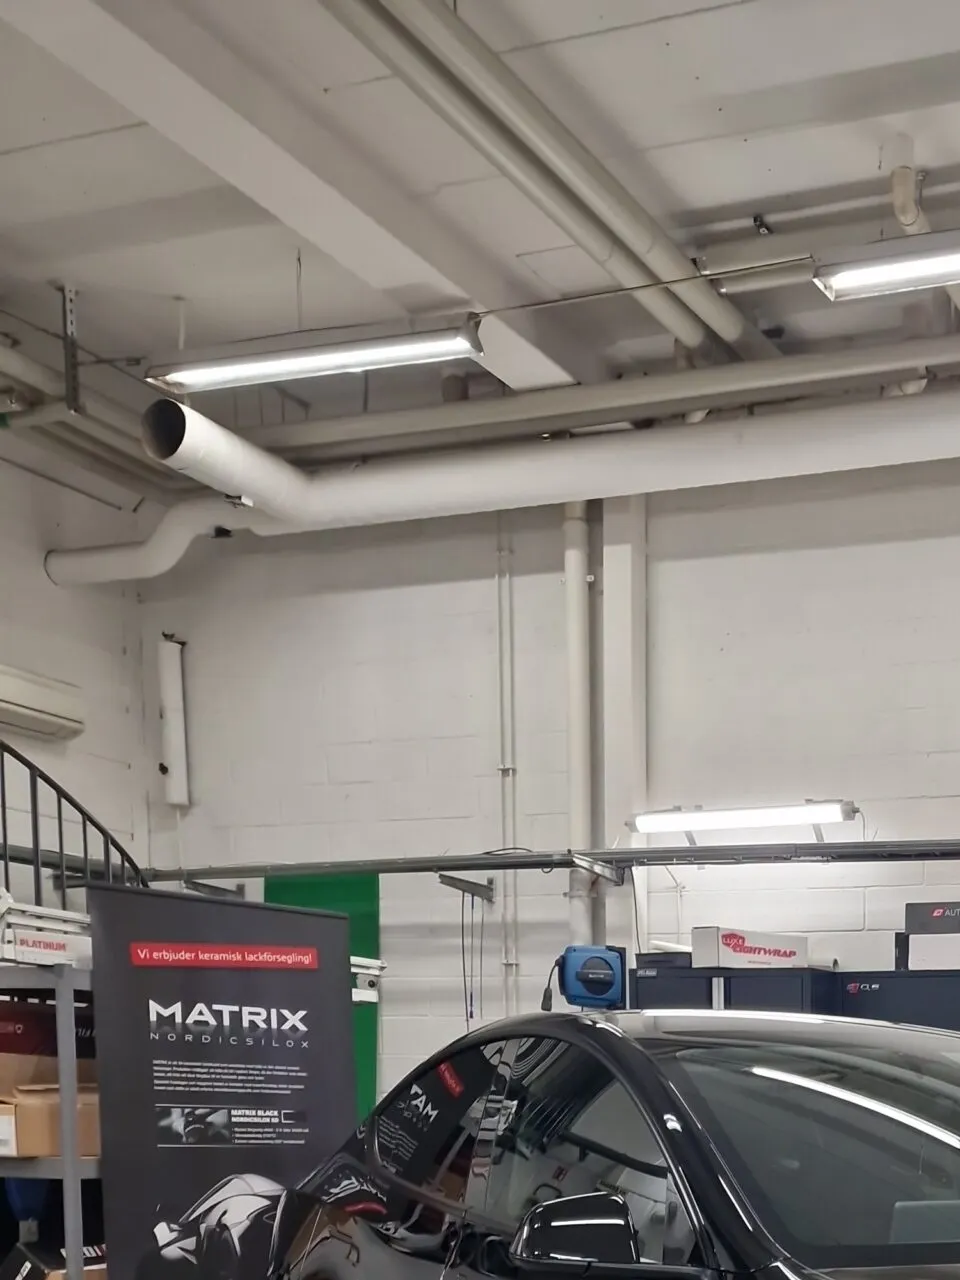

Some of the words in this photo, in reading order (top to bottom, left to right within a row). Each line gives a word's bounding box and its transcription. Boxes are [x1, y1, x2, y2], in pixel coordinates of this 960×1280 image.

[20, 938, 67, 952] PLATINUM
[137, 948, 150, 959] Vi
[152, 949, 195, 962] erbjuder
[198, 950, 242, 962] keramisk
[244, 951, 312, 965] lackförsegling!
[149, 999, 308, 1032] MATRIX
[150, 1032, 309, 1049] NORDICSILOX
